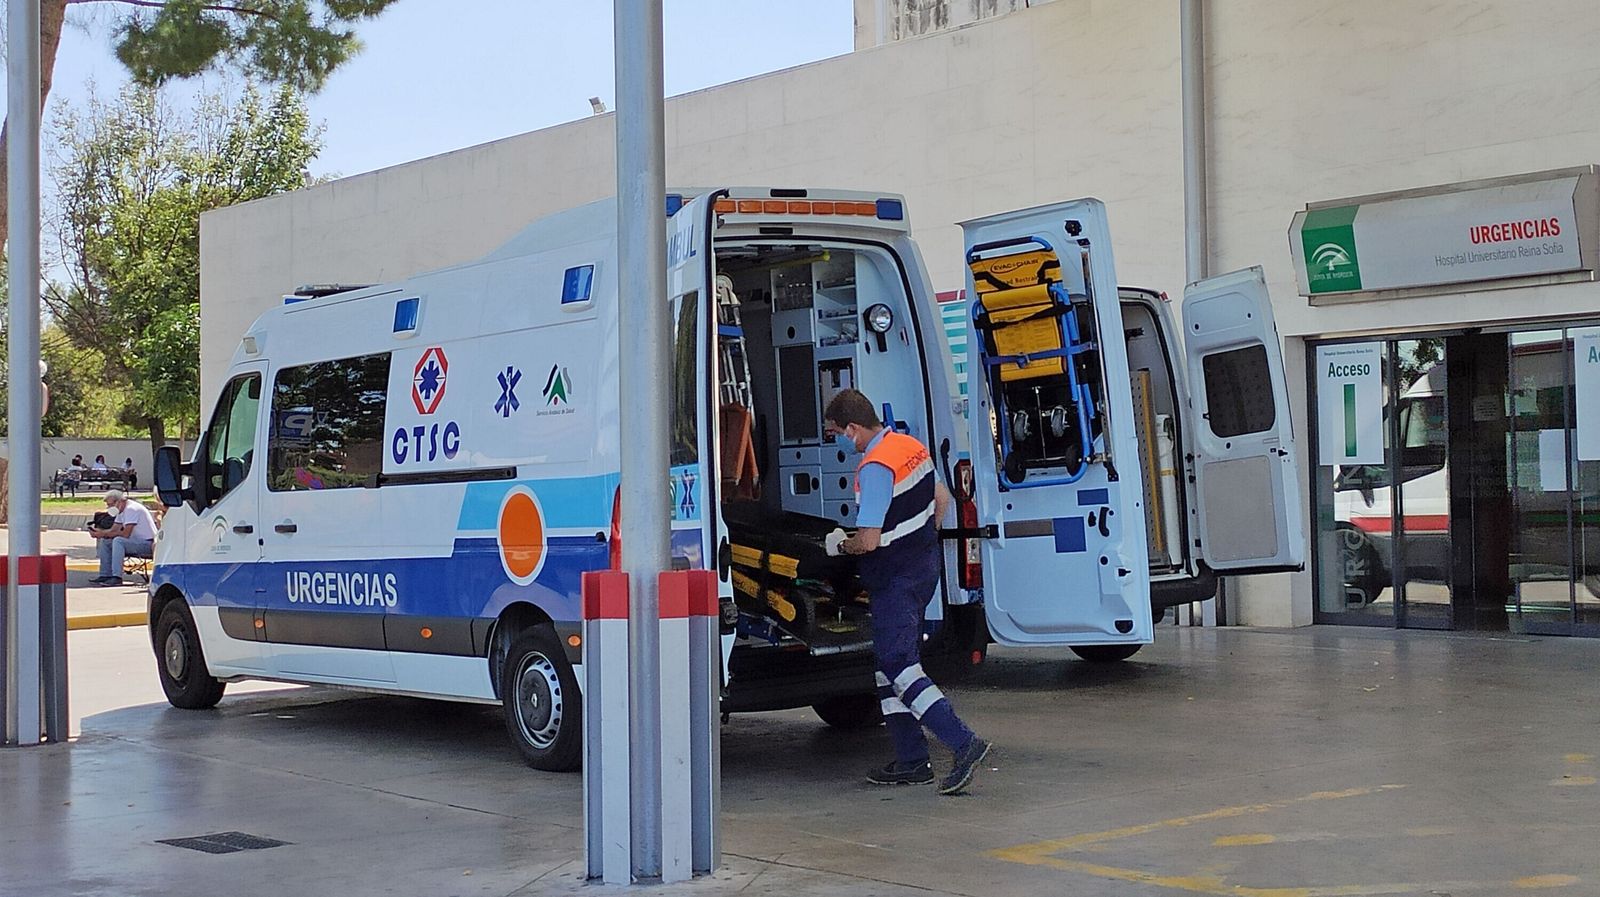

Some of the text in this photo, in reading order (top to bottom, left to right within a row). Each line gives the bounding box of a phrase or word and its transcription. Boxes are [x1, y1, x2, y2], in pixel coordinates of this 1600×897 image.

[1470, 217, 1560, 245] URGENCIAS
[1434, 252, 1467, 267] Hospital
[1468, 247, 1517, 263] Universitario
[1518, 245, 1542, 258] Reina
[1327, 361, 1371, 378] Acceso
[392, 421, 460, 465] CTSC
[286, 571, 398, 607] URGENCIAS
